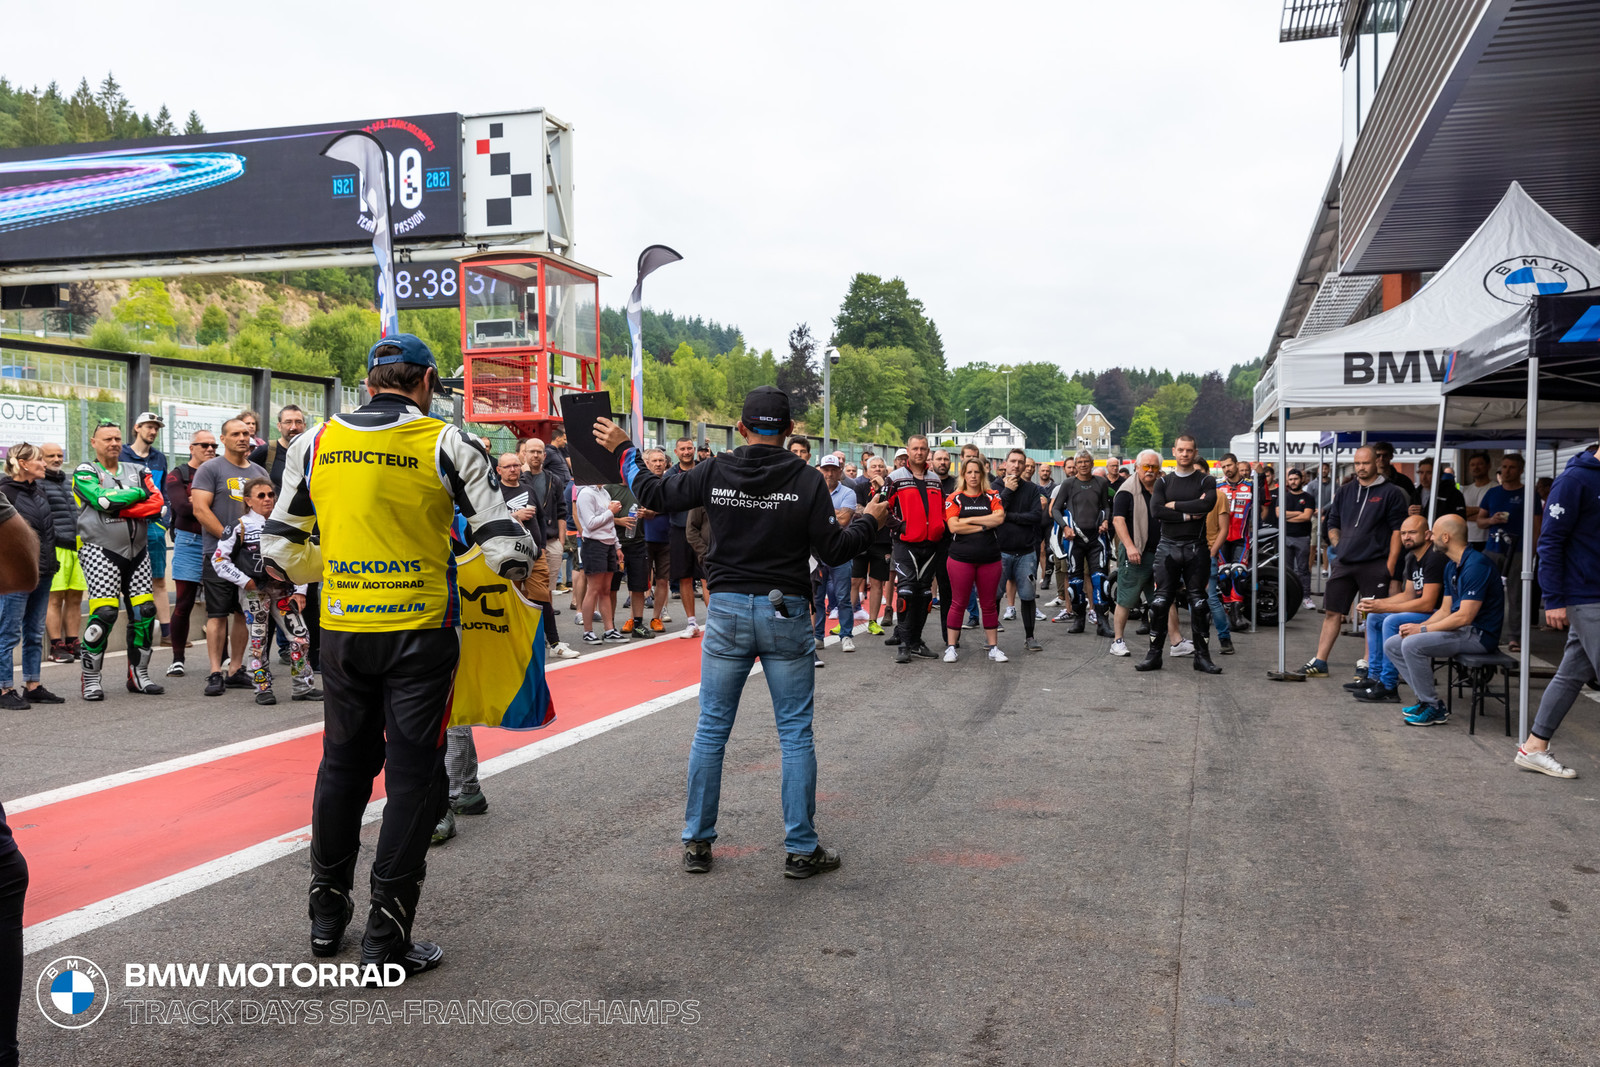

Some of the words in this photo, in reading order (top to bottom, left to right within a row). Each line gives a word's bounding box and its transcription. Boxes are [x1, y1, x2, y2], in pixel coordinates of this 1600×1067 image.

[332, 177, 355, 196] 1921
[425, 170, 451, 189] 2021
[393, 209, 426, 236] PASSION
[1494, 258, 1570, 276] BMW
[173, 419, 202, 431] OCATION
[318, 450, 419, 469] INSTRUCTEUR
[711, 488, 737, 497] BMW
[710, 496, 780, 510] MOTORSPORT
[328, 560, 421, 574] TRACKDAYS
[336, 581, 360, 589] BMW
[362, 580, 425, 590] MOTORRAD
[345, 602, 426, 614] MICHELIN
